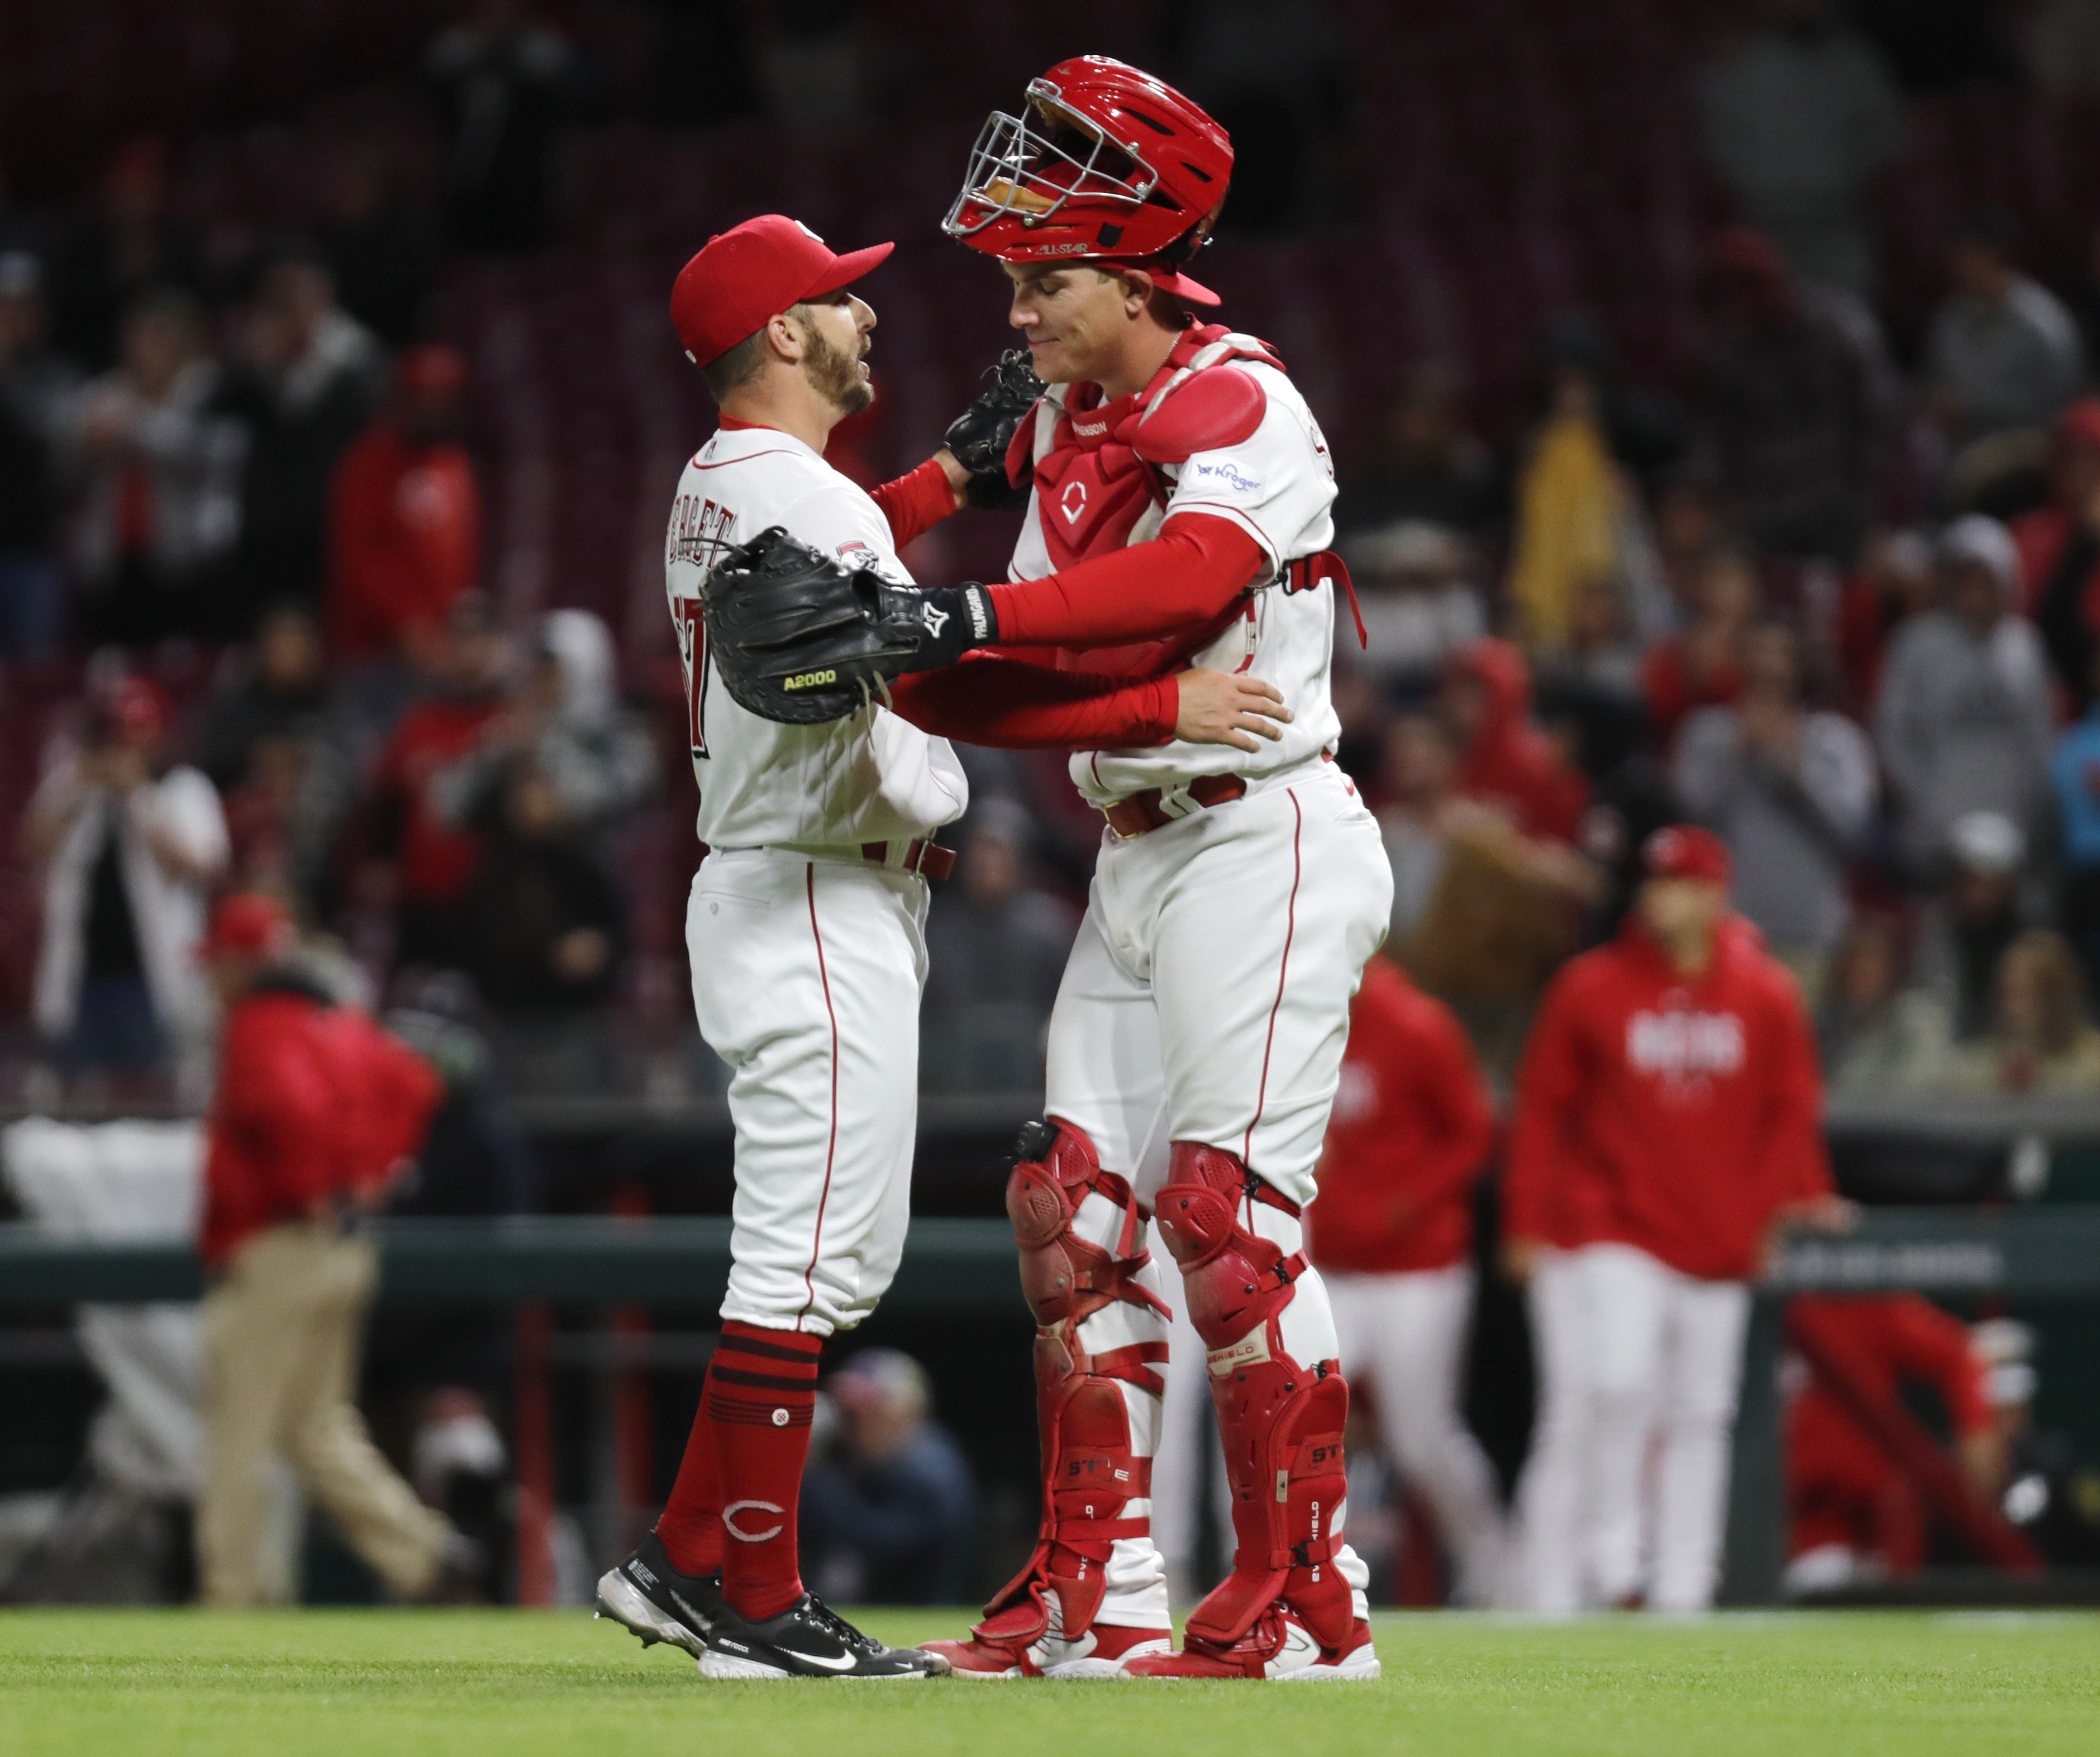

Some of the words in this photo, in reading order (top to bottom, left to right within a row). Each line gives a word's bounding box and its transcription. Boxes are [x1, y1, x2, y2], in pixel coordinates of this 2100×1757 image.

[1215, 463, 1261, 492] Kroger
[965, 588, 988, 639] PALMGARD
[783, 669, 836, 691] A2000
